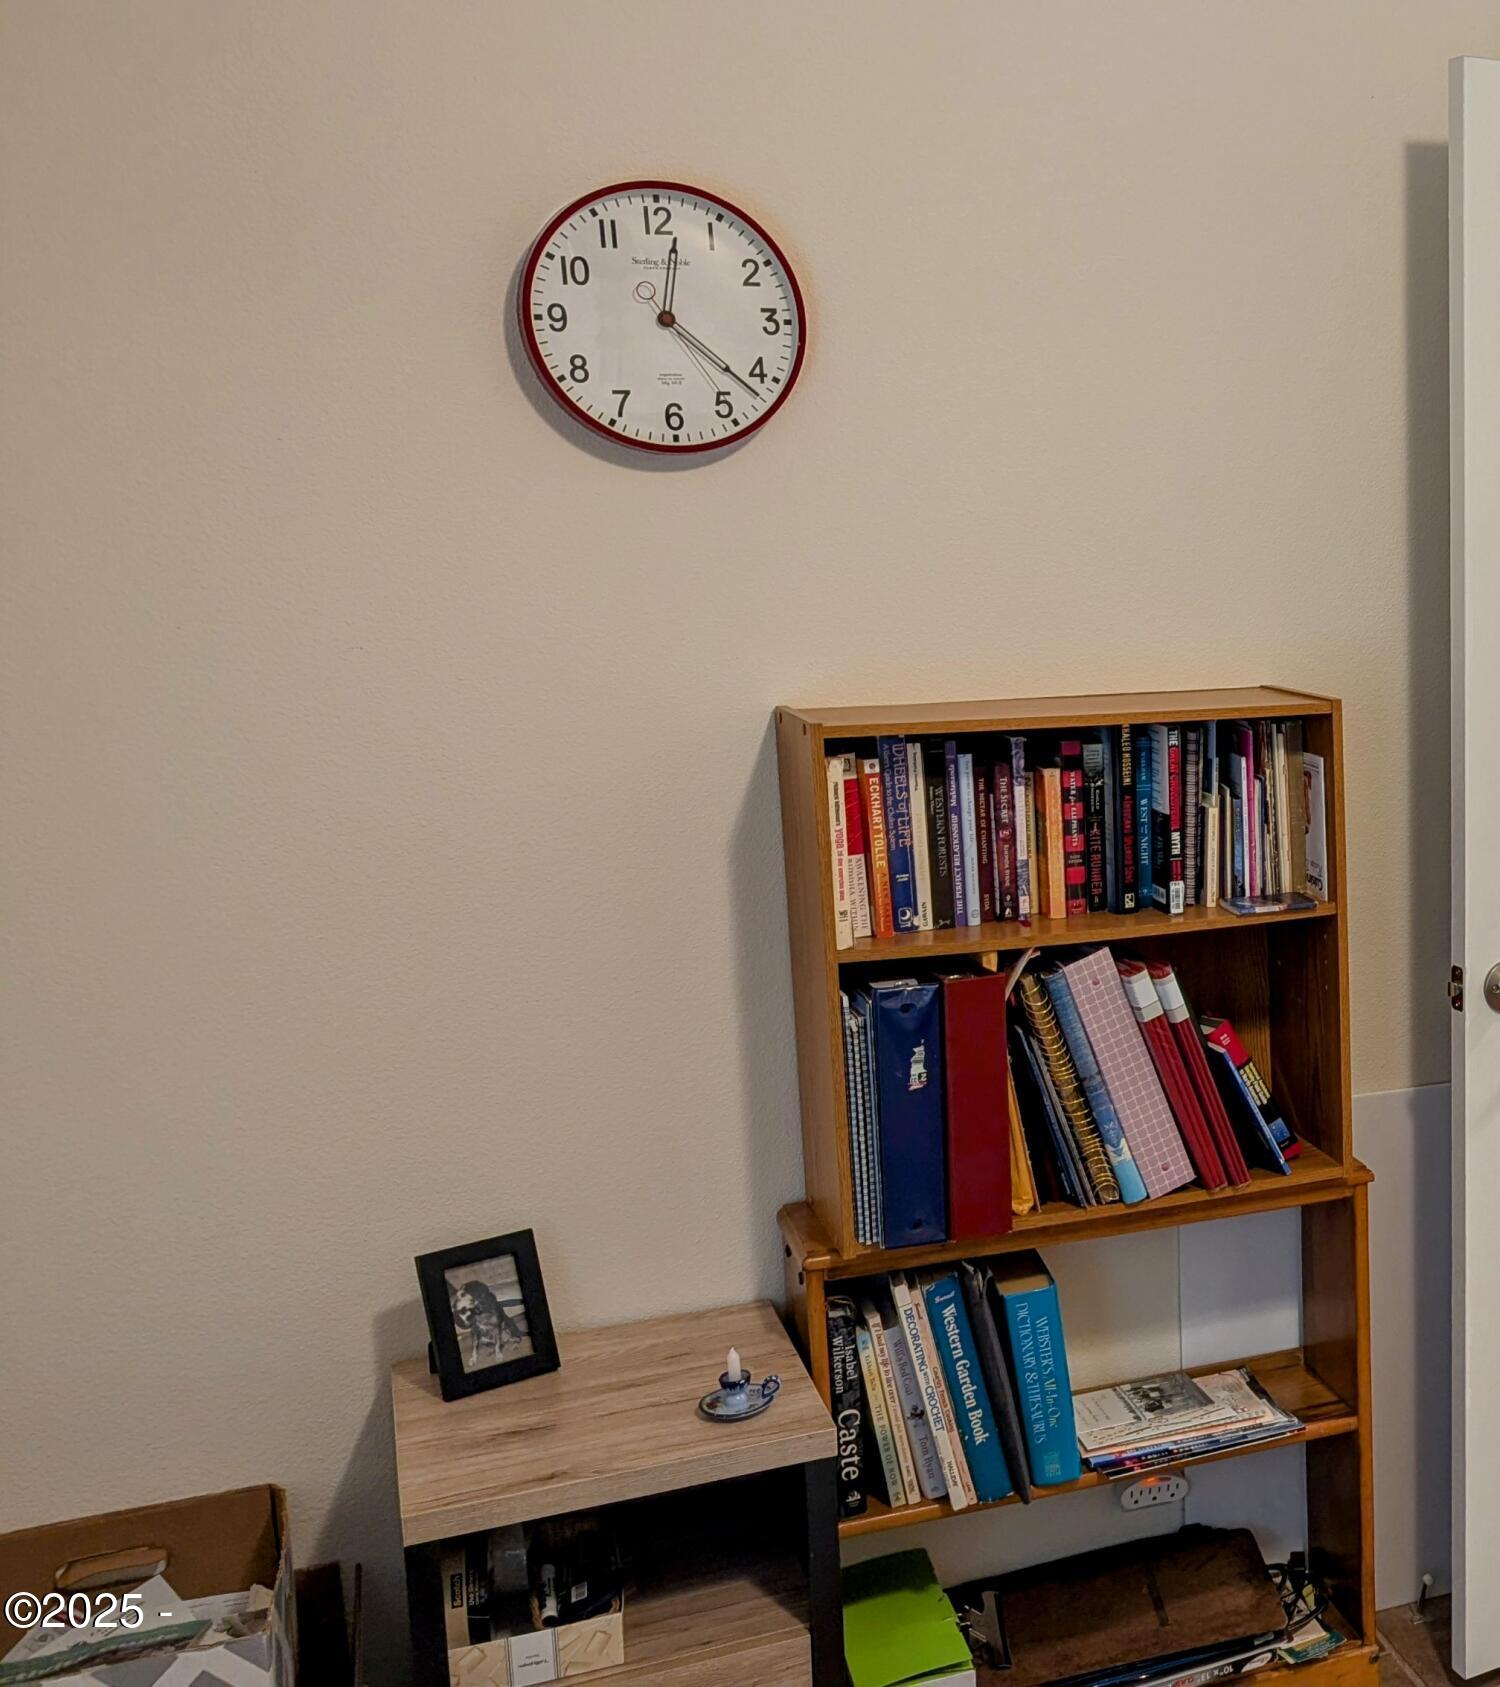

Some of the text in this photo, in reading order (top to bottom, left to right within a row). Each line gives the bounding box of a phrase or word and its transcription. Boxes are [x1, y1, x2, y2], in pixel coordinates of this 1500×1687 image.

[599, 219, 618, 248] 11
[643, 206, 673, 235] 12
[707, 222, 715, 250] 1
[560, 255, 590, 286] 10
[632, 256, 659, 266] Sterling
[741, 259, 761, 286] 2
[547, 303, 568, 332] 9
[760, 307, 780, 335] 3
[569, 354, 590, 383] 8
[748, 356, 768, 384] 4
[611, 389, 631, 418] 7
[664, 402, 685, 430] 6
[714, 390, 733, 418] 5
[1168, 730, 1178, 746] THE
[1121, 724, 1133, 786] KHALED HOSSEINI
[892, 743, 907, 800] WHEELS
[869, 777, 881, 829] ECKHART
[999, 776, 1009, 823] THE SECRET
[1140, 798, 1148, 823] WEST
[834, 828, 844, 849] yoga
[934, 785, 947, 877] WESTERN FORESTS
[951, 813, 961, 866] RELATIONSHIP
[1071, 807, 1079, 847] ELEPHANTS
[1090, 830, 1102, 852] KITE
[873, 831, 886, 868] TOLLE
[1140, 836, 1149, 866] NIGHT
[1171, 831, 1181, 855] MYTH
[855, 857, 867, 911] AWAKENING
[1091, 854, 1103, 895] RUNNER
[956, 900, 964, 915] THE
[832, 1335, 844, 1395] Wilkerson
[843, 1341, 858, 1381] Isabel
[899, 1362, 911, 1378] Red
[903, 1306, 928, 1372] DECORATING
[925, 1384, 944, 1432] CROCHET
[941, 1302, 990, 1446] Western Garden Book
[1016, 1302, 1046, 1444] DICTIONARY & THESAURUS
[903, 1378, 914, 1396] Coat
[875, 1405, 884, 1423] THE
[837, 1408, 861, 1482] Caste
[878, 1425, 890, 1453] POWER
[885, 1454, 894, 1465] OF
[919, 1436, 936, 1480] Tom Ryan
[888, 1468, 898, 1487] NOW
[946, 1459, 959, 1488] HALLIDAY
[452, 1575, 462, 1606] Scotch
